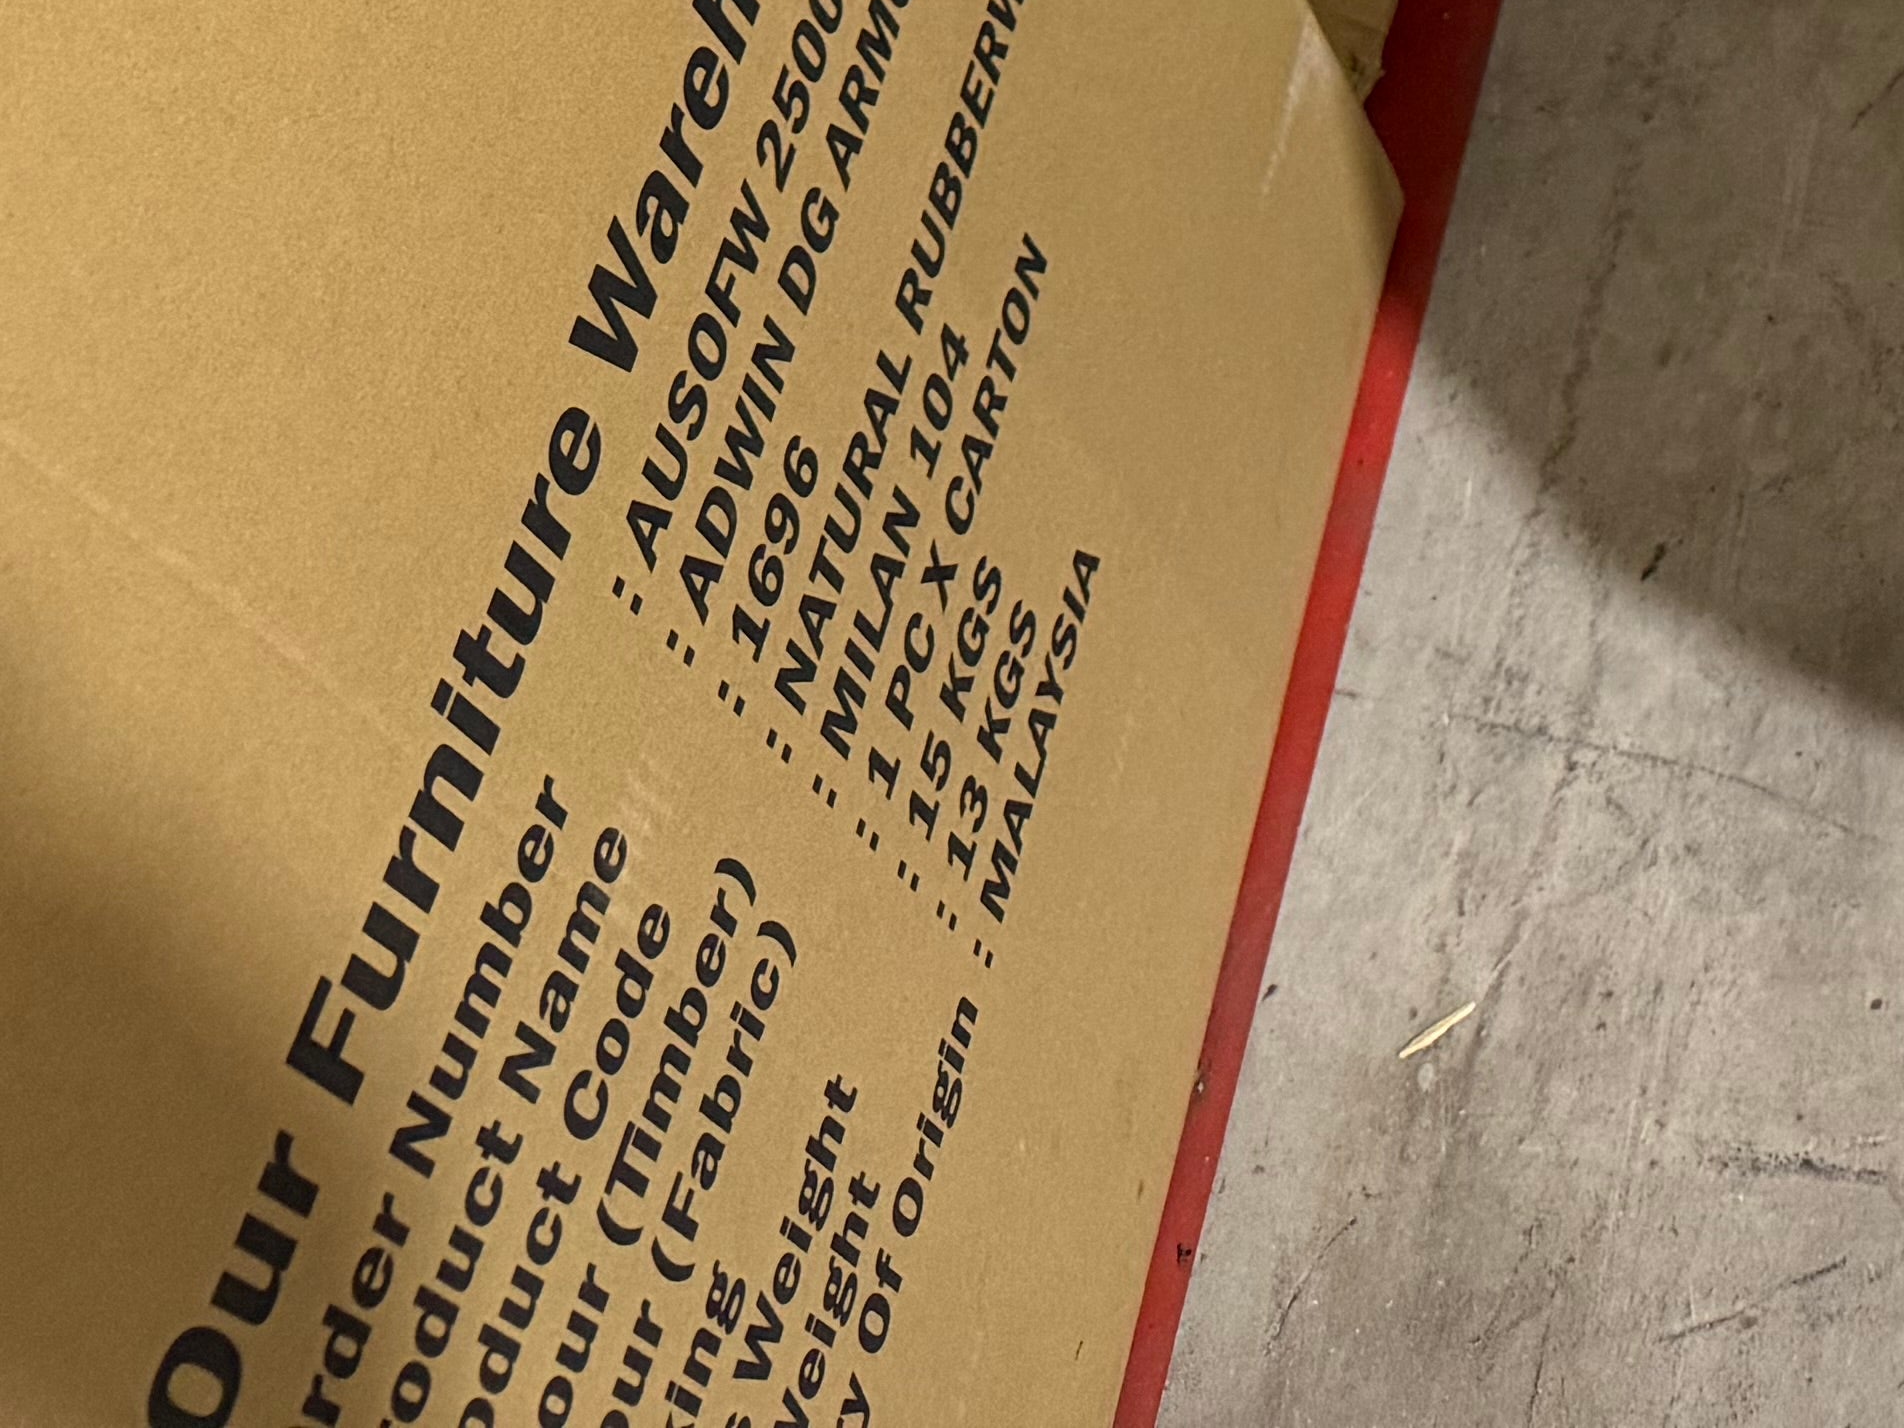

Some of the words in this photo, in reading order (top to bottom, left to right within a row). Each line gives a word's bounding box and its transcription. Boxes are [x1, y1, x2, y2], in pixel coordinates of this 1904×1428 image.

[146, 1129, 321, 1428] Our
[285, 406, 602, 1107] Furniture
[288, 1191, 411, 1428] rder
[388, 773, 569, 1180] Number
[625, 177, 771, 574] AUSOFW
[498, 826, 628, 1105] Name
[678, 313, 796, 627] ADWIN
[776, 186, 840, 317] DG
[563, 903, 671, 1141] Code
[731, 434, 819, 664] 1696
[595, 857, 757, 1247] (Timber)
[773, 349, 913, 717] NATURAL
[650, 920, 797, 1283] (Fabric)
[819, 484, 921, 762] MILAN
[909, 322, 970, 481] 104
[867, 746, 901, 801] 1
[884, 611, 935, 732] PC
[919, 538, 959, 615] X
[944, 232, 1048, 536] CARTON
[947, 774, 989, 883] 13
[976, 599, 1037, 765] KGS
[731, 1073, 858, 1381] Weight
[908, 729, 952, 843] 15
[938, 555, 1002, 724] KGS
[857, 1247, 903, 1355] Of
[891, 996, 979, 1238] Origin
[979, 549, 1101, 924] MALAYSIA
